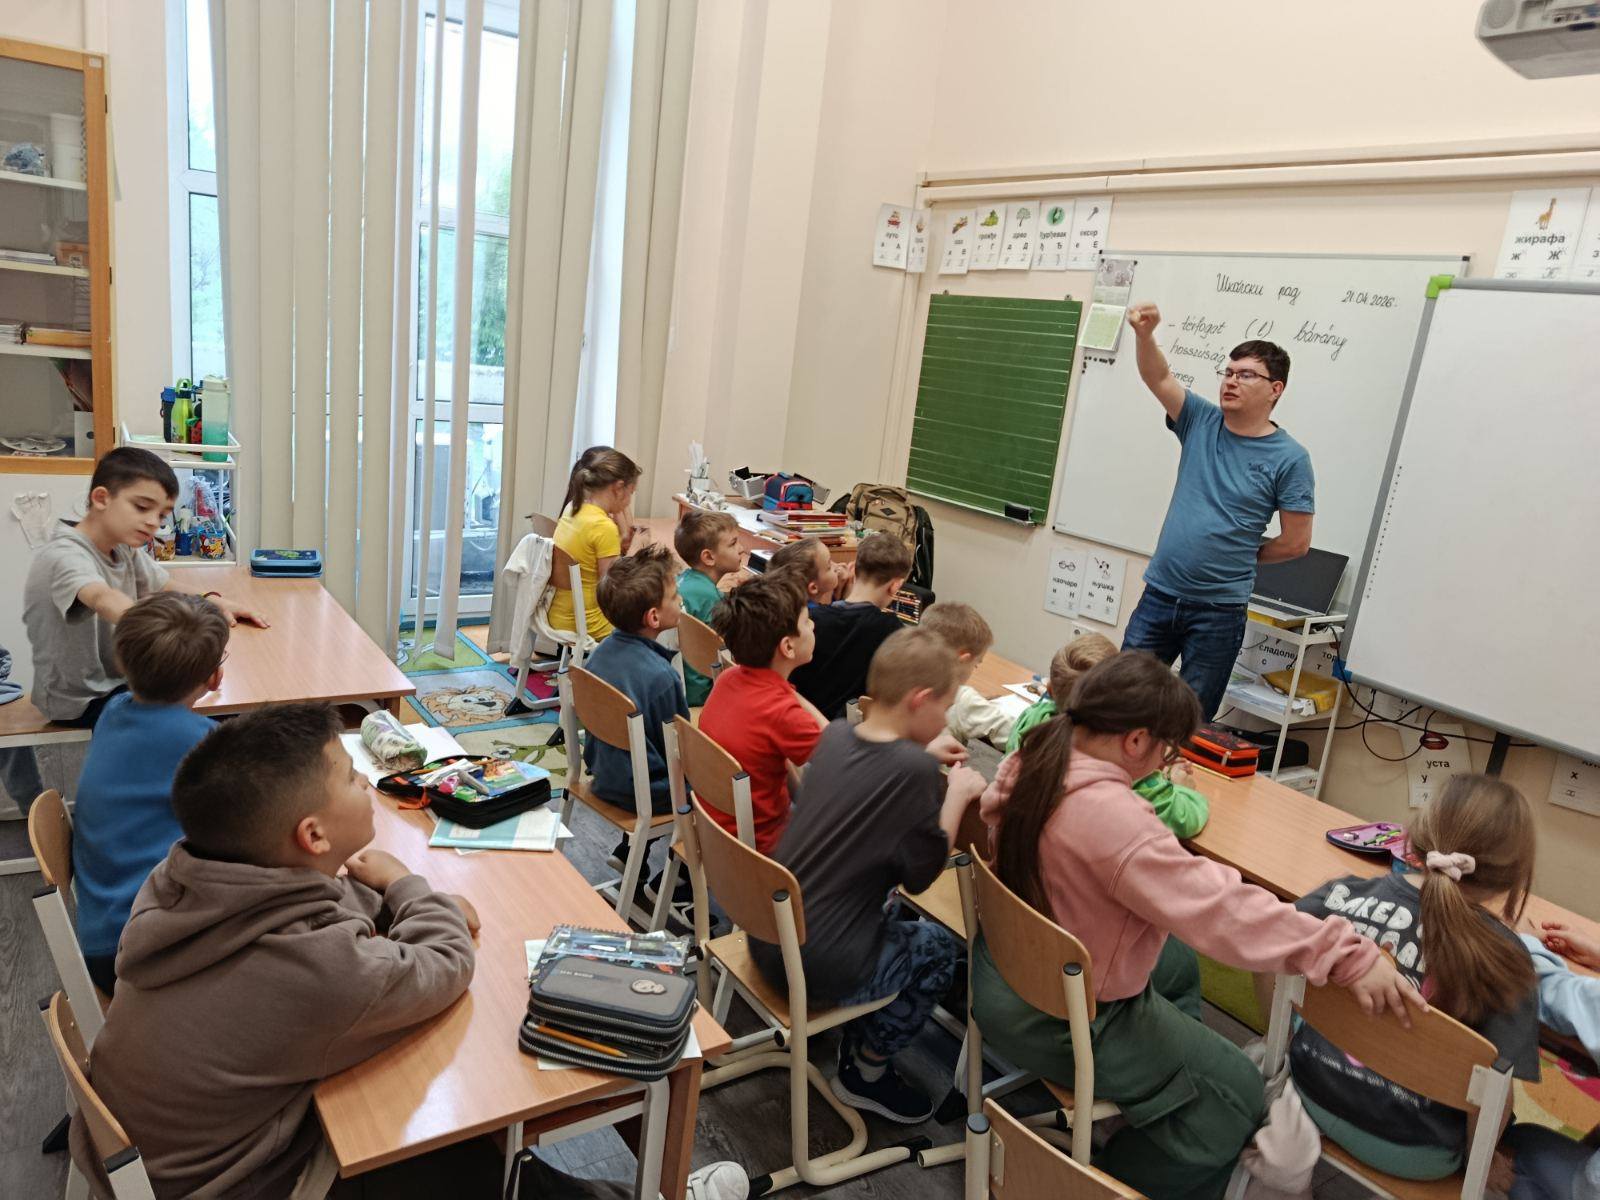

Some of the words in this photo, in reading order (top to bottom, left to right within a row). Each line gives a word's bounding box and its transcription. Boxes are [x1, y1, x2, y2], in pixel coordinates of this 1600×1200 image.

[1514, 233, 1566, 246] жирафа
[1511, 252, 1521, 261] ж
[1547, 250, 1561, 260] Ж
[1592, 249, 1600, 258] з
[1277, 285, 1301, 307] рад
[1293, 320, 1349, 362] bárány
[1258, 643, 1297, 660] сладоле
[1426, 758, 1451, 769] уста
[1421, 773, 1428, 784] у
